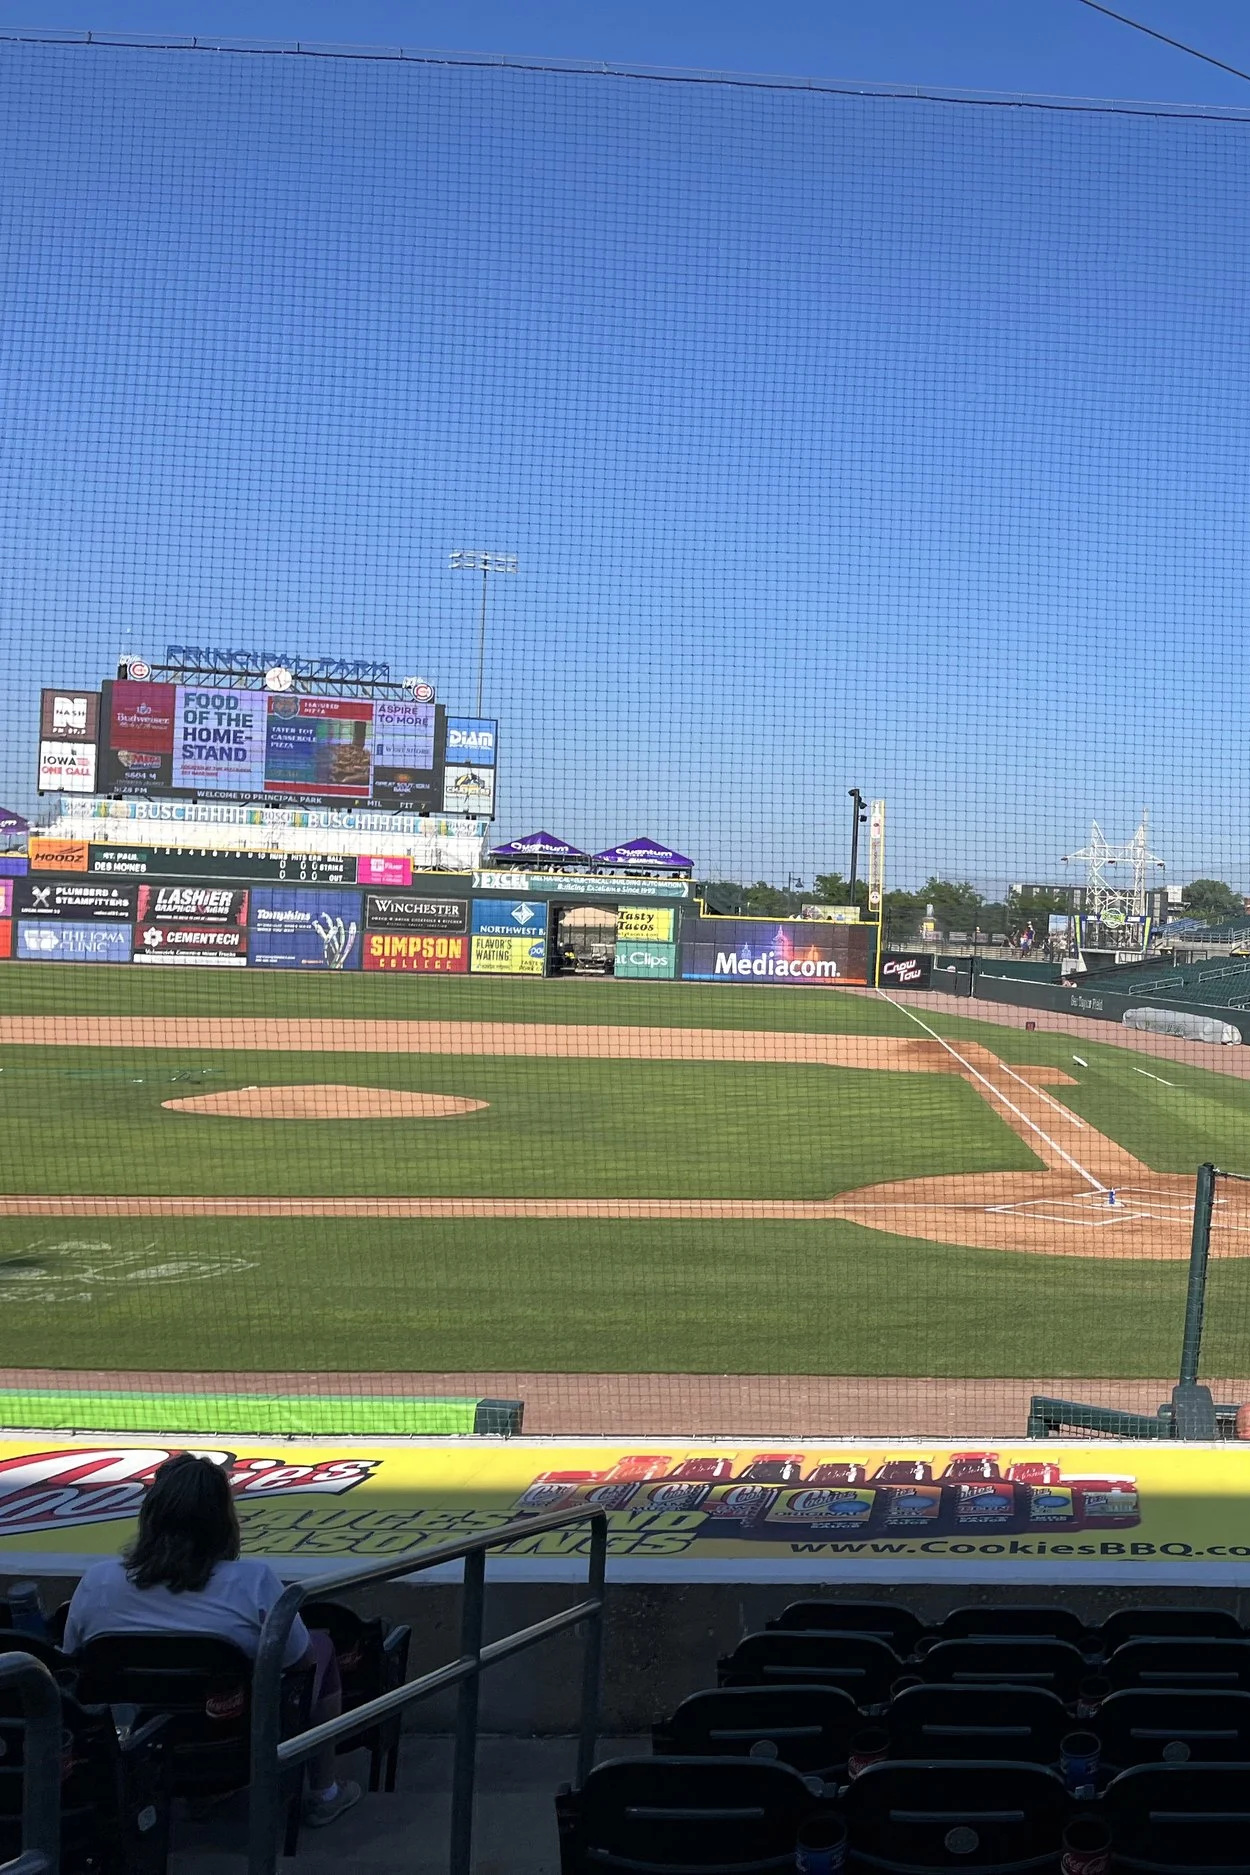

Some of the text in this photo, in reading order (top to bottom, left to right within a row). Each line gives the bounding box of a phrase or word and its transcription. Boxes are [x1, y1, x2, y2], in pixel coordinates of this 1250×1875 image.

[167, 645, 309, 671] PRINCIPAL
[319, 657, 389, 676] PARK
[184, 693, 239, 710] FOOD
[378, 705, 418, 715] ASPIRE
[117, 712, 170, 724] Budweiser
[184, 710, 253, 728] OF THE
[379, 714, 428, 726] TO MORE
[183, 727, 253, 745] HOME-
[182, 744, 247, 762] STAND
[43, 755, 76, 766] IOWA
[41, 766, 92, 776] ONE CALL
[197, 790, 238, 799] WELCOME
[253, 794, 298, 802] PRINCIPAL
[511, 842, 569, 853] Quantum
[616, 848, 673, 857] Quantum
[35, 853, 84, 862] HOODZ
[94, 862, 147, 873] DES MOINES
[319, 864, 344, 872] STRIKE
[329, 874, 343, 882] OUT
[482, 873, 528, 888] EXCEL
[55, 887, 109, 897] PLUMBERS
[621, 886, 640, 894] Since
[55, 897, 130, 907] STEAMFITTERS
[375, 900, 459, 915] WINCHESTER
[257, 909, 311, 921] Tompkins
[617, 911, 654, 923] Tasty
[480, 926, 537, 935] NORTHWEST
[617, 921, 654, 931] Tacos
[62, 931, 125, 944] THE IOWA
[167, 932, 240, 946] CEMENTECH
[60, 942, 107, 953] CLINIC
[370, 935, 462, 958] SIMPSON
[476, 938, 512, 950] FLAVOR'S
[379, 958, 452, 969] COLLEGE
[629, 951, 668, 968] Clips
[884, 959, 917, 974] Crow
[898, 968, 922, 983] Tow
